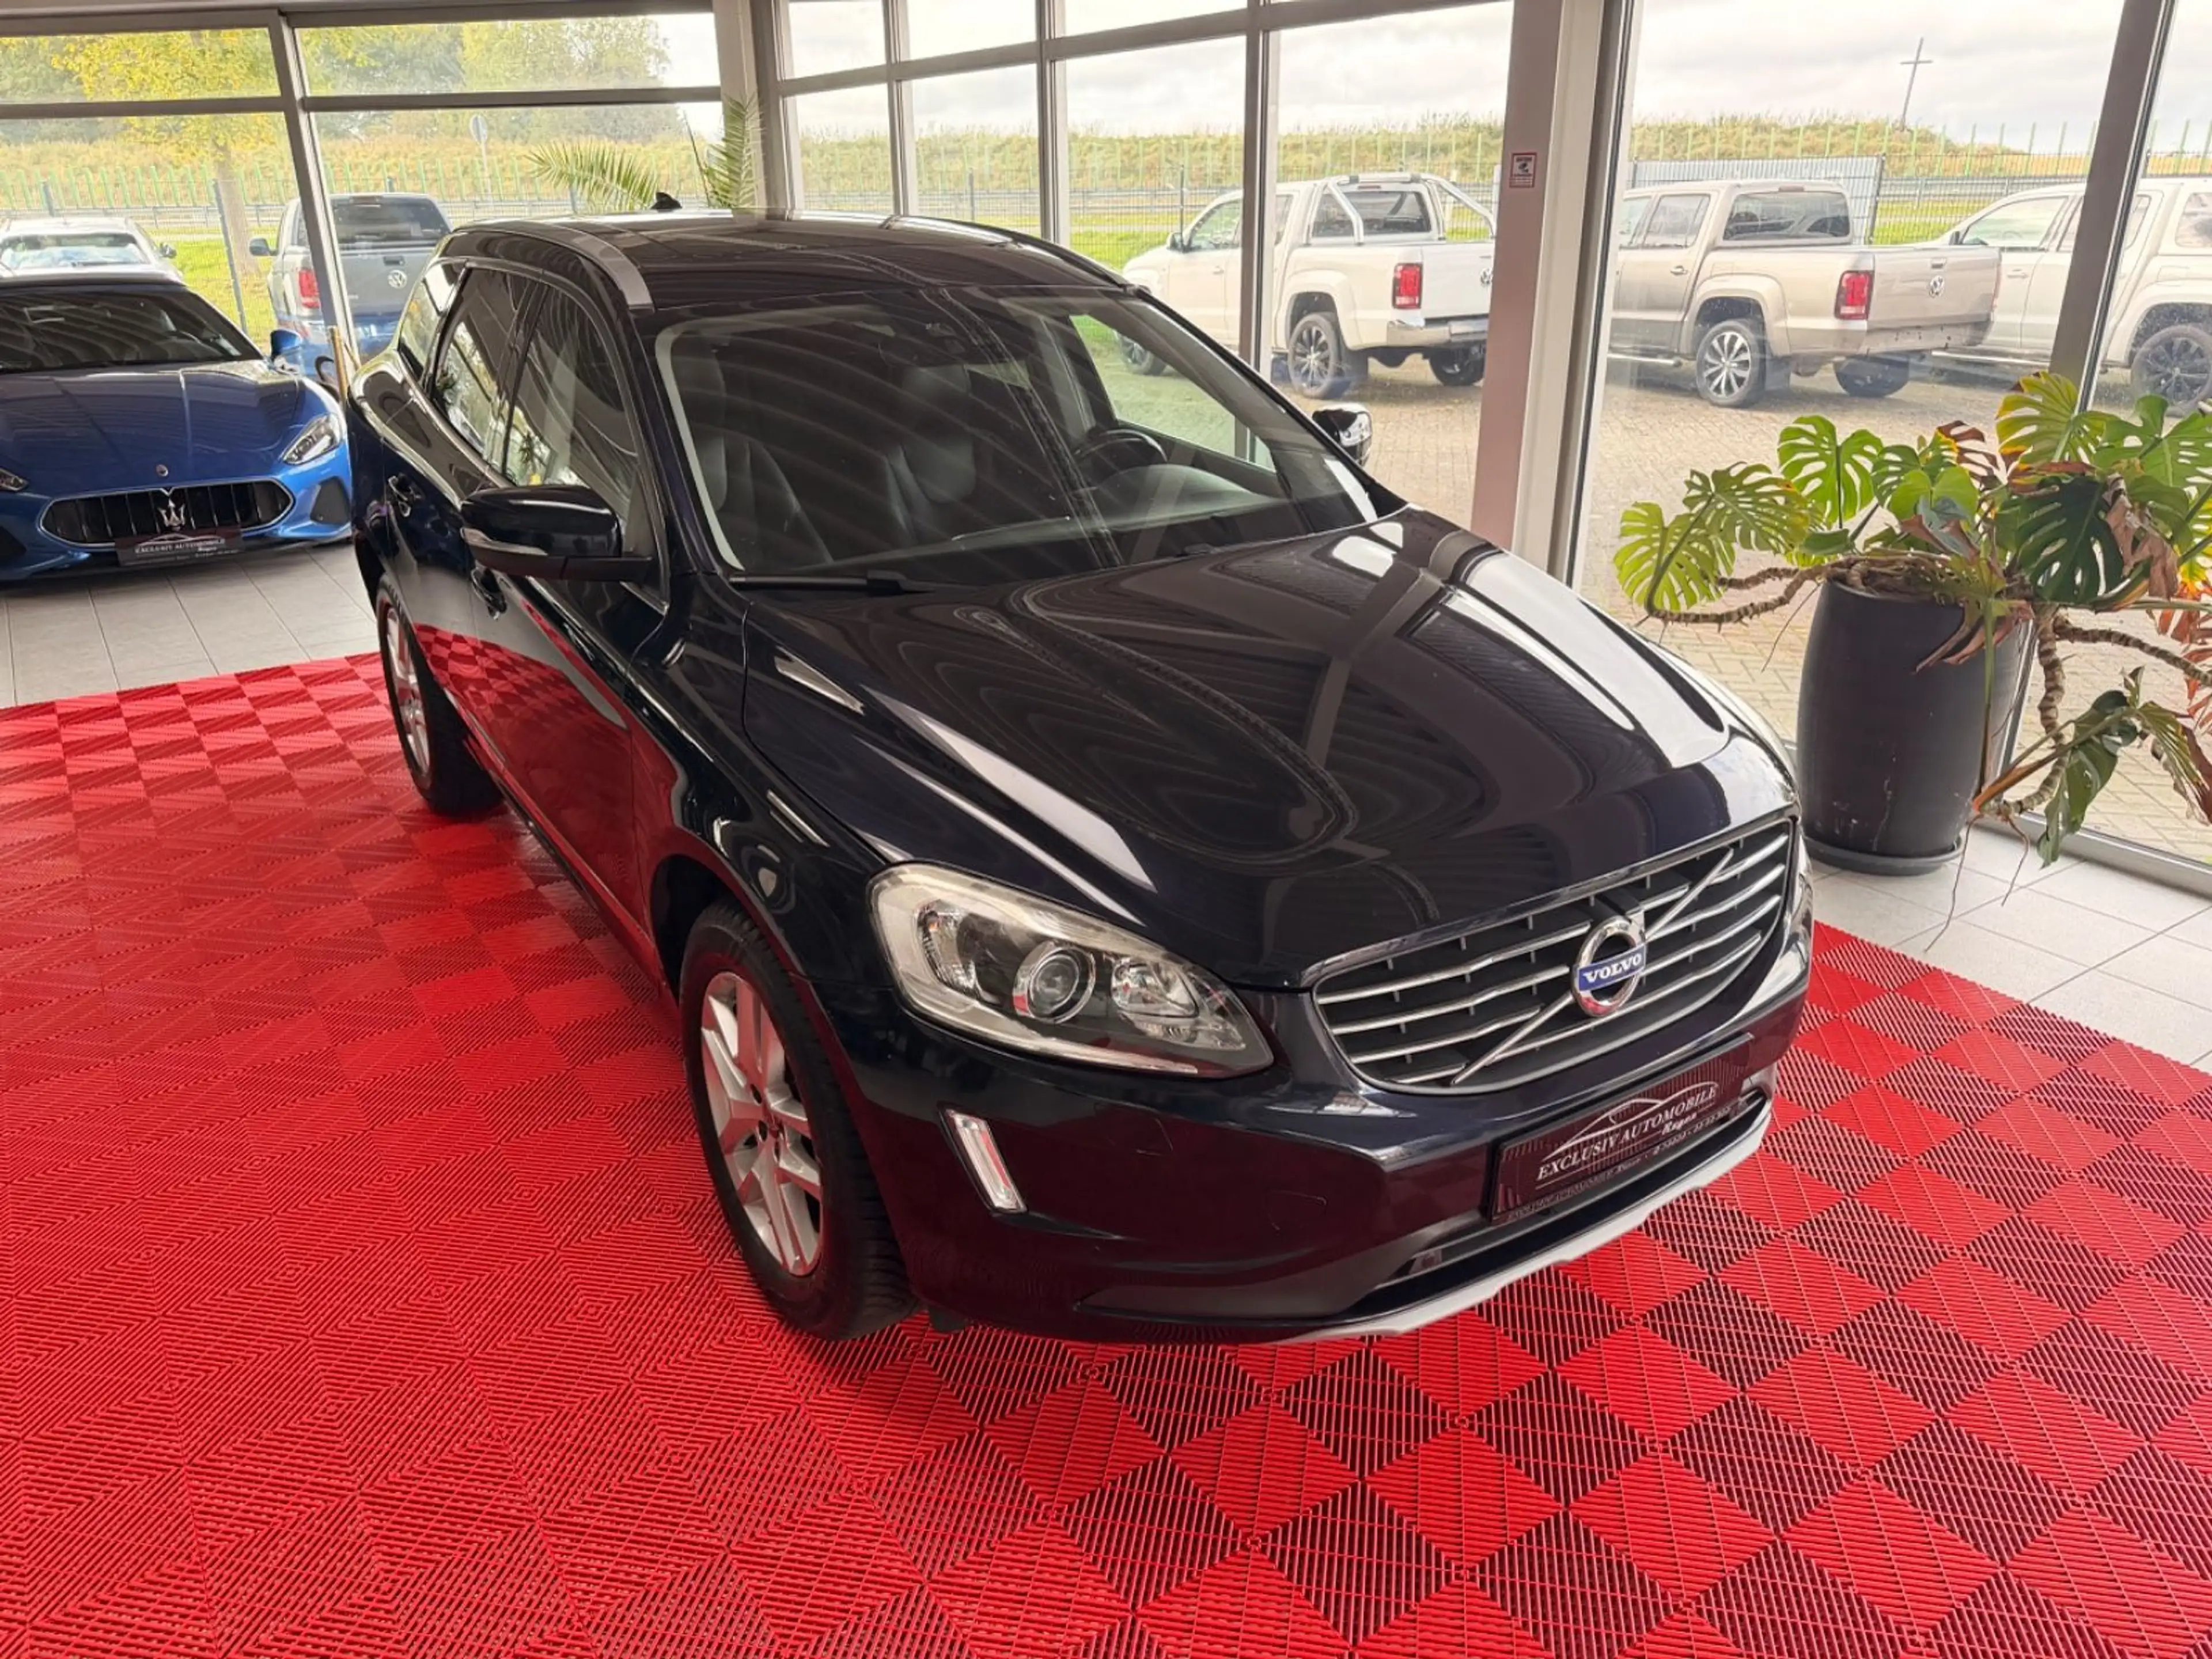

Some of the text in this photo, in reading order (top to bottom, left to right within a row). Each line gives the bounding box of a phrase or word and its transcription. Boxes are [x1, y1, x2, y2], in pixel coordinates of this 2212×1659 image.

[1582, 953, 1642, 983] VOLVO
[1536, 1132, 1620, 1181] EXCLUSIV
[1619, 1086, 1717, 1144] AUTOMOBILE
